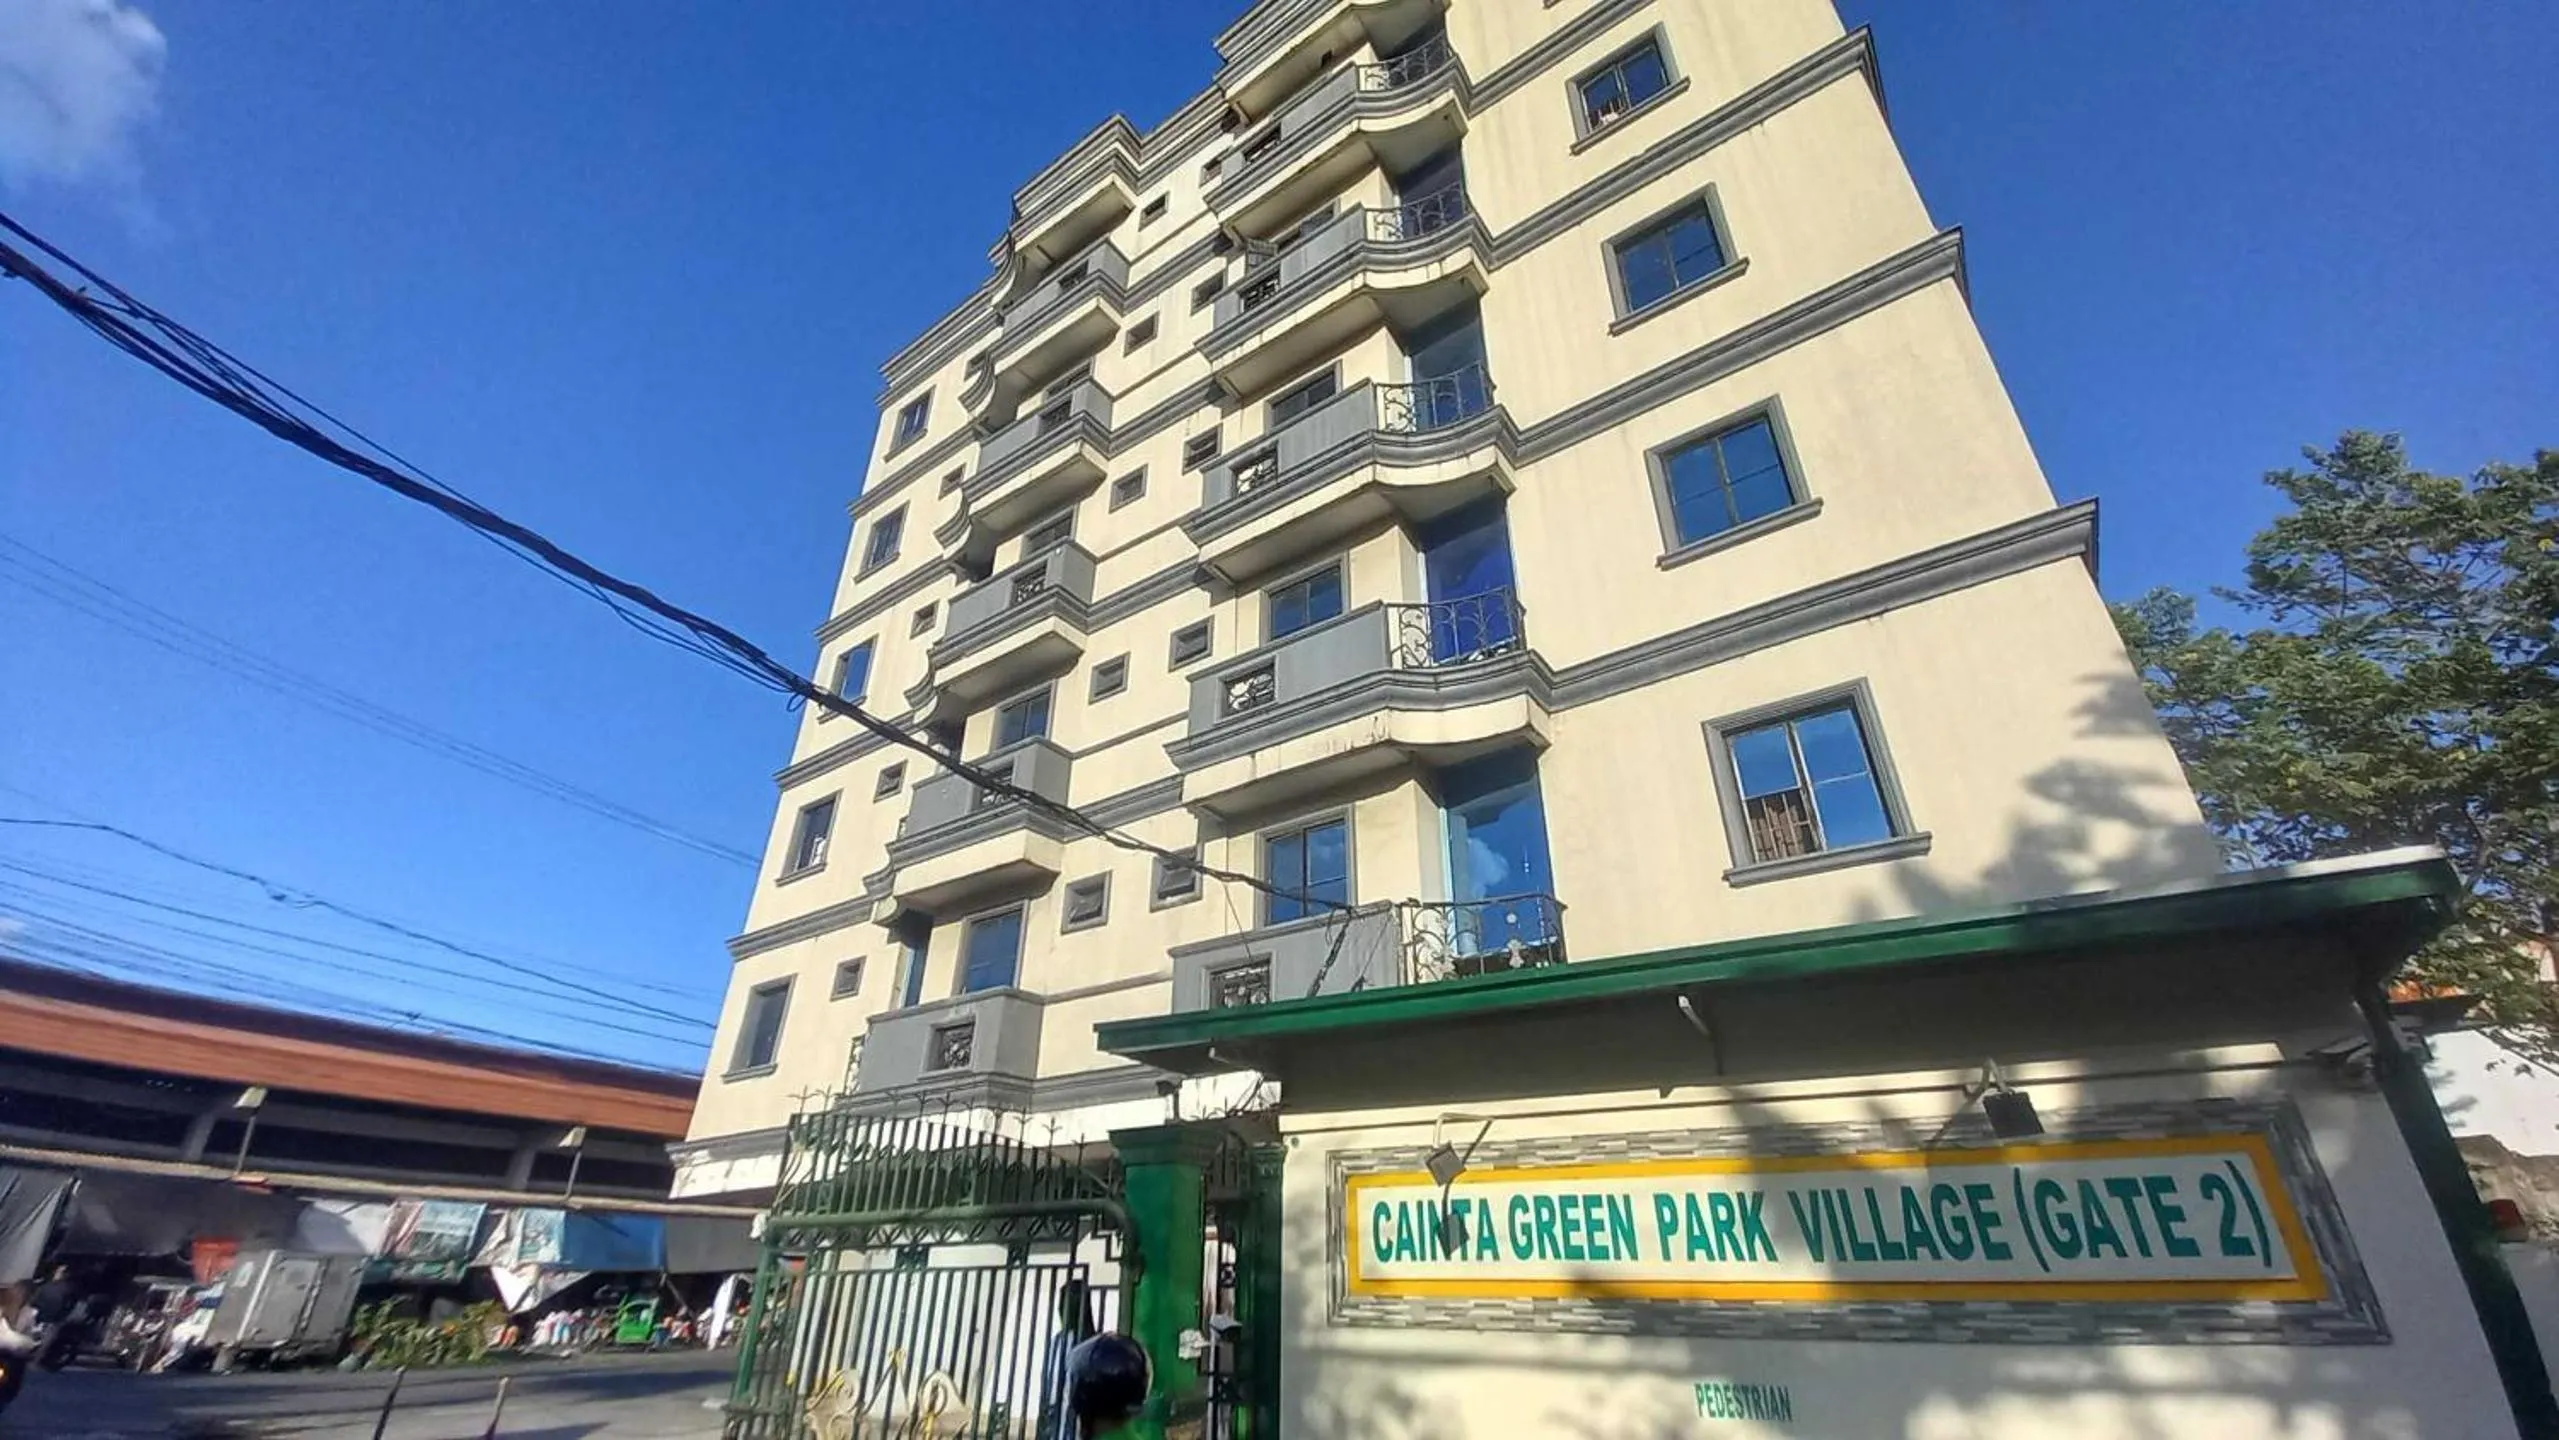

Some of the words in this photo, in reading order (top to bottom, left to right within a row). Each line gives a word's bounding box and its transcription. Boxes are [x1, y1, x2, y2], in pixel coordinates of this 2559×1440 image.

[1372, 1197, 1500, 1263] CAINTA
[1507, 1193, 1639, 1261] GREEN
[1654, 1190, 1779, 1263] PARK
[1787, 1183, 2014, 1263] VILLAGE
[2013, 1167, 2201, 1272] (GATE
[2201, 1160, 2273, 1267] 2)
[1694, 1383, 1793, 1422] PEDESTRIAN
